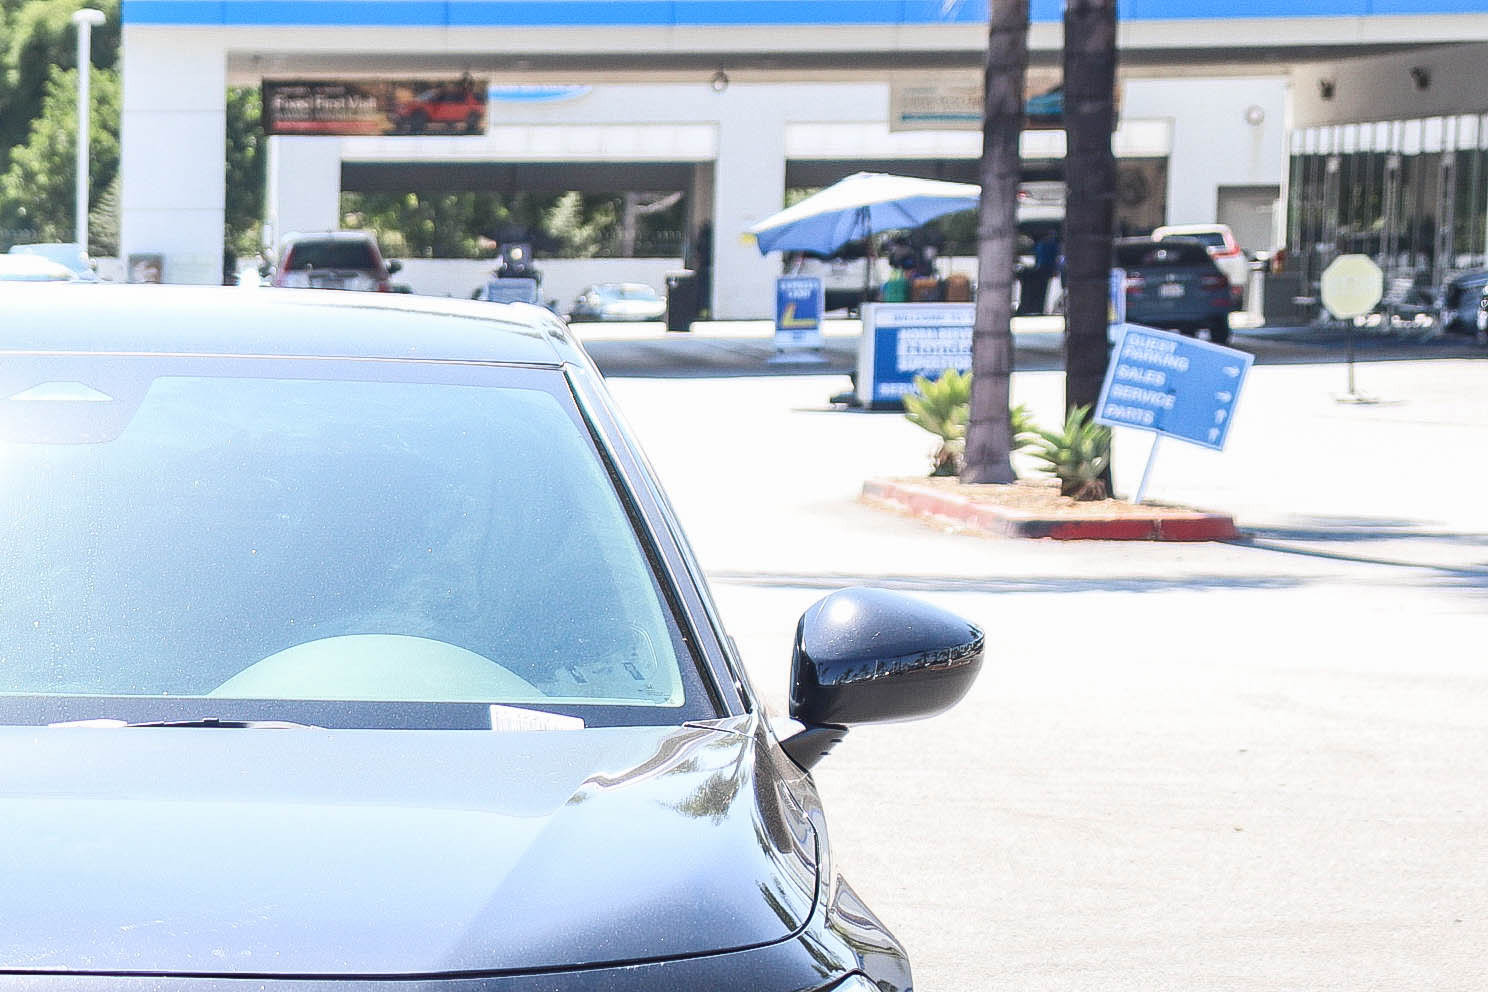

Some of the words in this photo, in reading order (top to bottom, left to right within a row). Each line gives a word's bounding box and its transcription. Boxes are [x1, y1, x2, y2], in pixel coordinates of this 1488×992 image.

[1121, 345, 1190, 372] PARKING
[1116, 364, 1166, 387] SALES
[1110, 383, 1176, 410] SERVICE
[1104, 403, 1154, 426] PARTS
